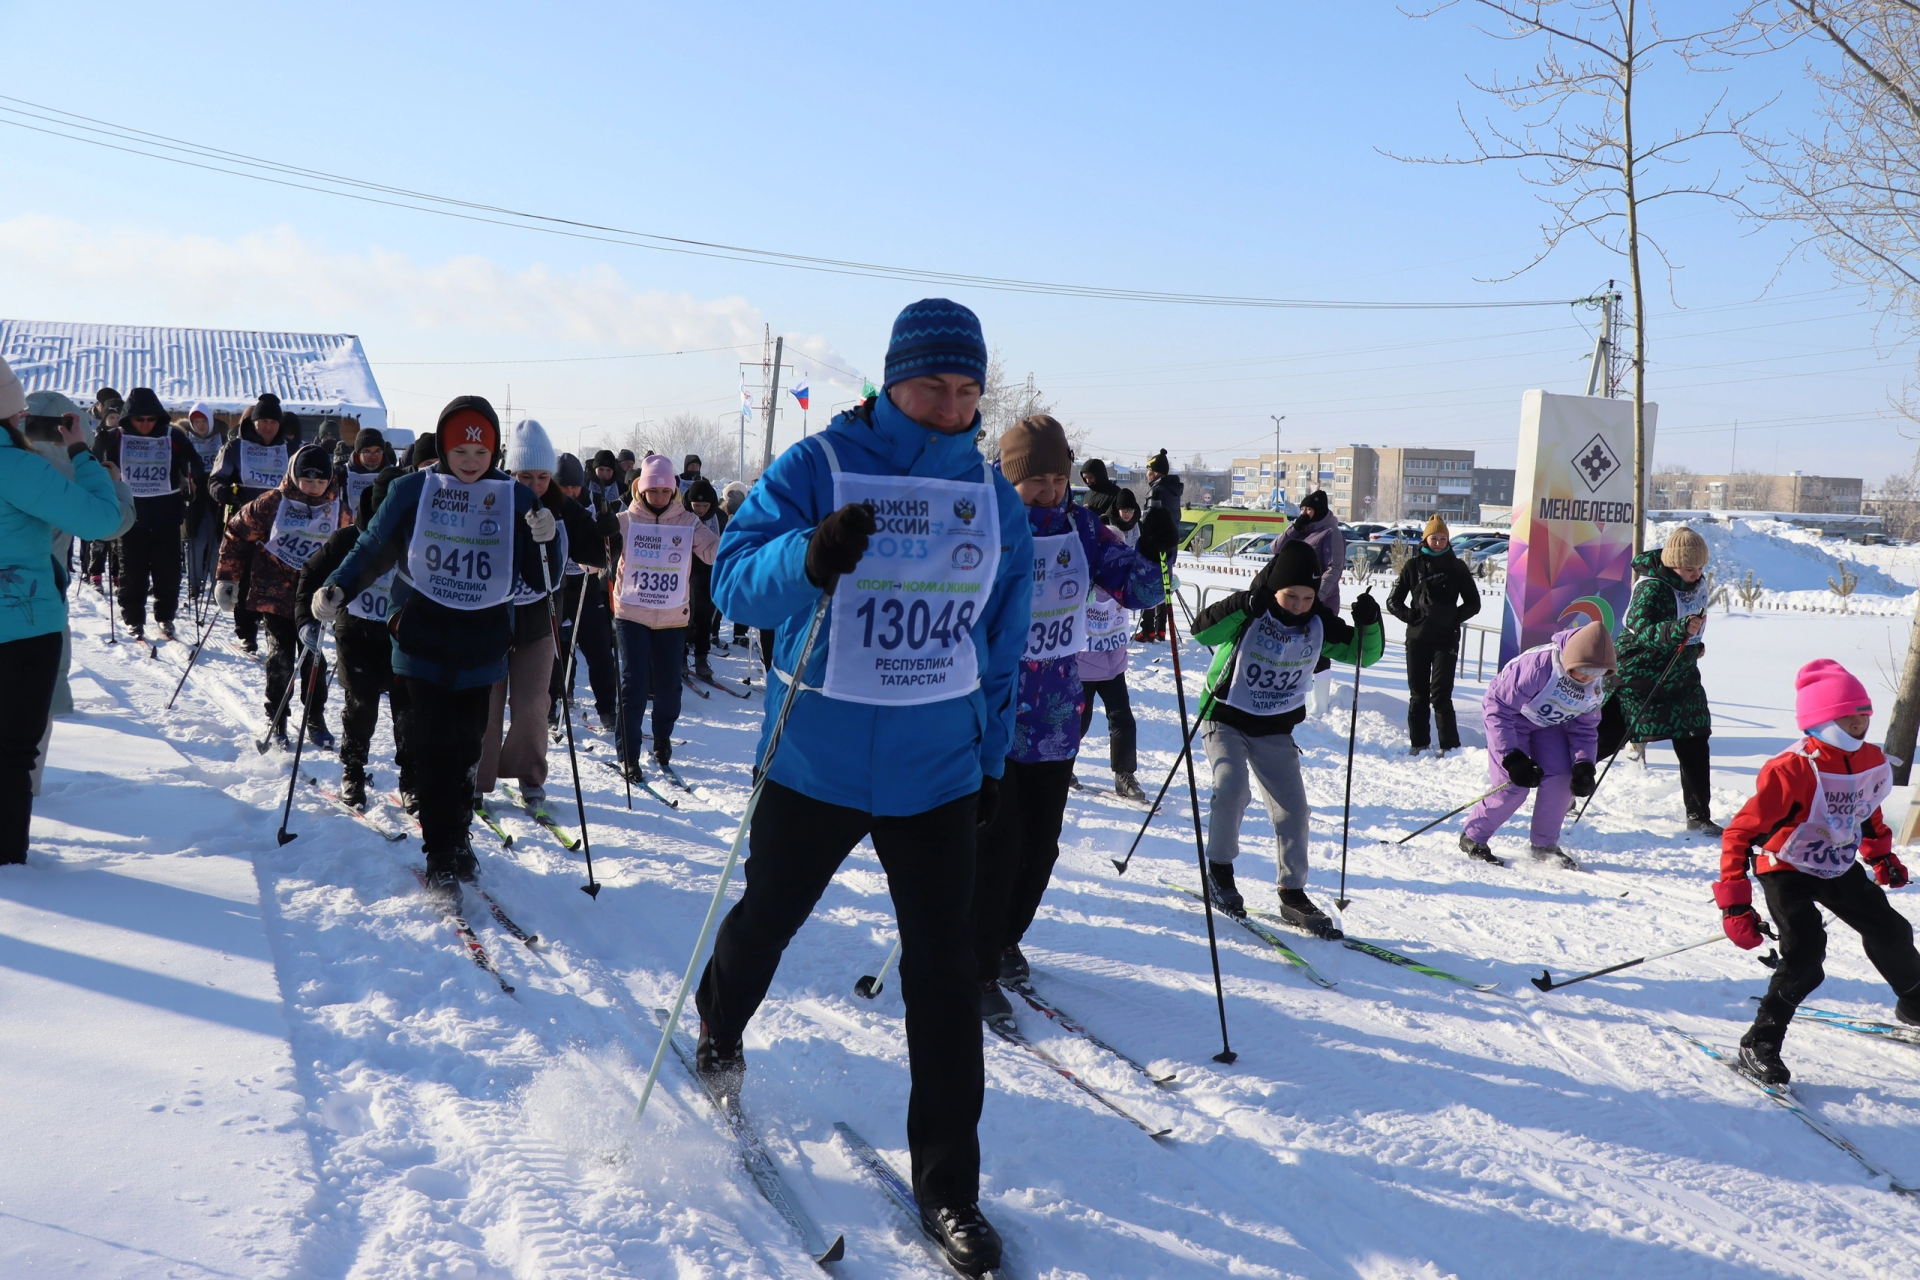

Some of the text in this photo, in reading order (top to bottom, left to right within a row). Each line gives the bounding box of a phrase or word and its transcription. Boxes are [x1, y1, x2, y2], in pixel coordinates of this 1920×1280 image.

[466, 426, 482, 442] NY
[125, 466, 167, 481] 14429
[433, 488, 469, 501] ЛЫЖНЯ
[432, 498, 468, 513] РОССИИ
[429, 511, 465, 528] 2021
[874, 516, 929, 535] ОССИИ
[424, 530, 446, 541] СПОРТ
[452, 536, 474, 544] НОРМА
[634, 535, 662, 543] ЛЫЖНЯ
[634, 541, 661, 550] РОССИИ
[634, 549, 660, 558] 2023
[425, 544, 492, 580] 9416
[429, 574, 487, 592] РЕСПУБЛИКА
[631, 571, 679, 592] 13389
[856, 579, 980, 593] СПОРТ НОРМА ЖИЗНИ
[432, 586, 482, 602] ТАТАРСТАН
[1032, 609, 1056, 619] ОРМА
[856, 597, 976, 650] 13048
[1023, 615, 1074, 655] 398
[1259, 623, 1292, 643] РОССИИ
[802, 619, 822, 666] FISCHER
[1086, 632, 1128, 652] 14269
[876, 657, 953, 670] РЕСПУБЛИКА
[1250, 652, 1269, 663] СПОРТ
[880, 672, 946, 686] ТАТАРСТАН
[1246, 664, 1302, 691] 9332
[1559, 676, 1585, 694] ЛЫЖНЯ
[1250, 690, 1295, 699] РЕСПУБЛИКА
[1552, 690, 1579, 706] 2021
[1556, 682, 1585, 701] РОССИИ
[1358, 944, 1404, 961] ACTIVE
